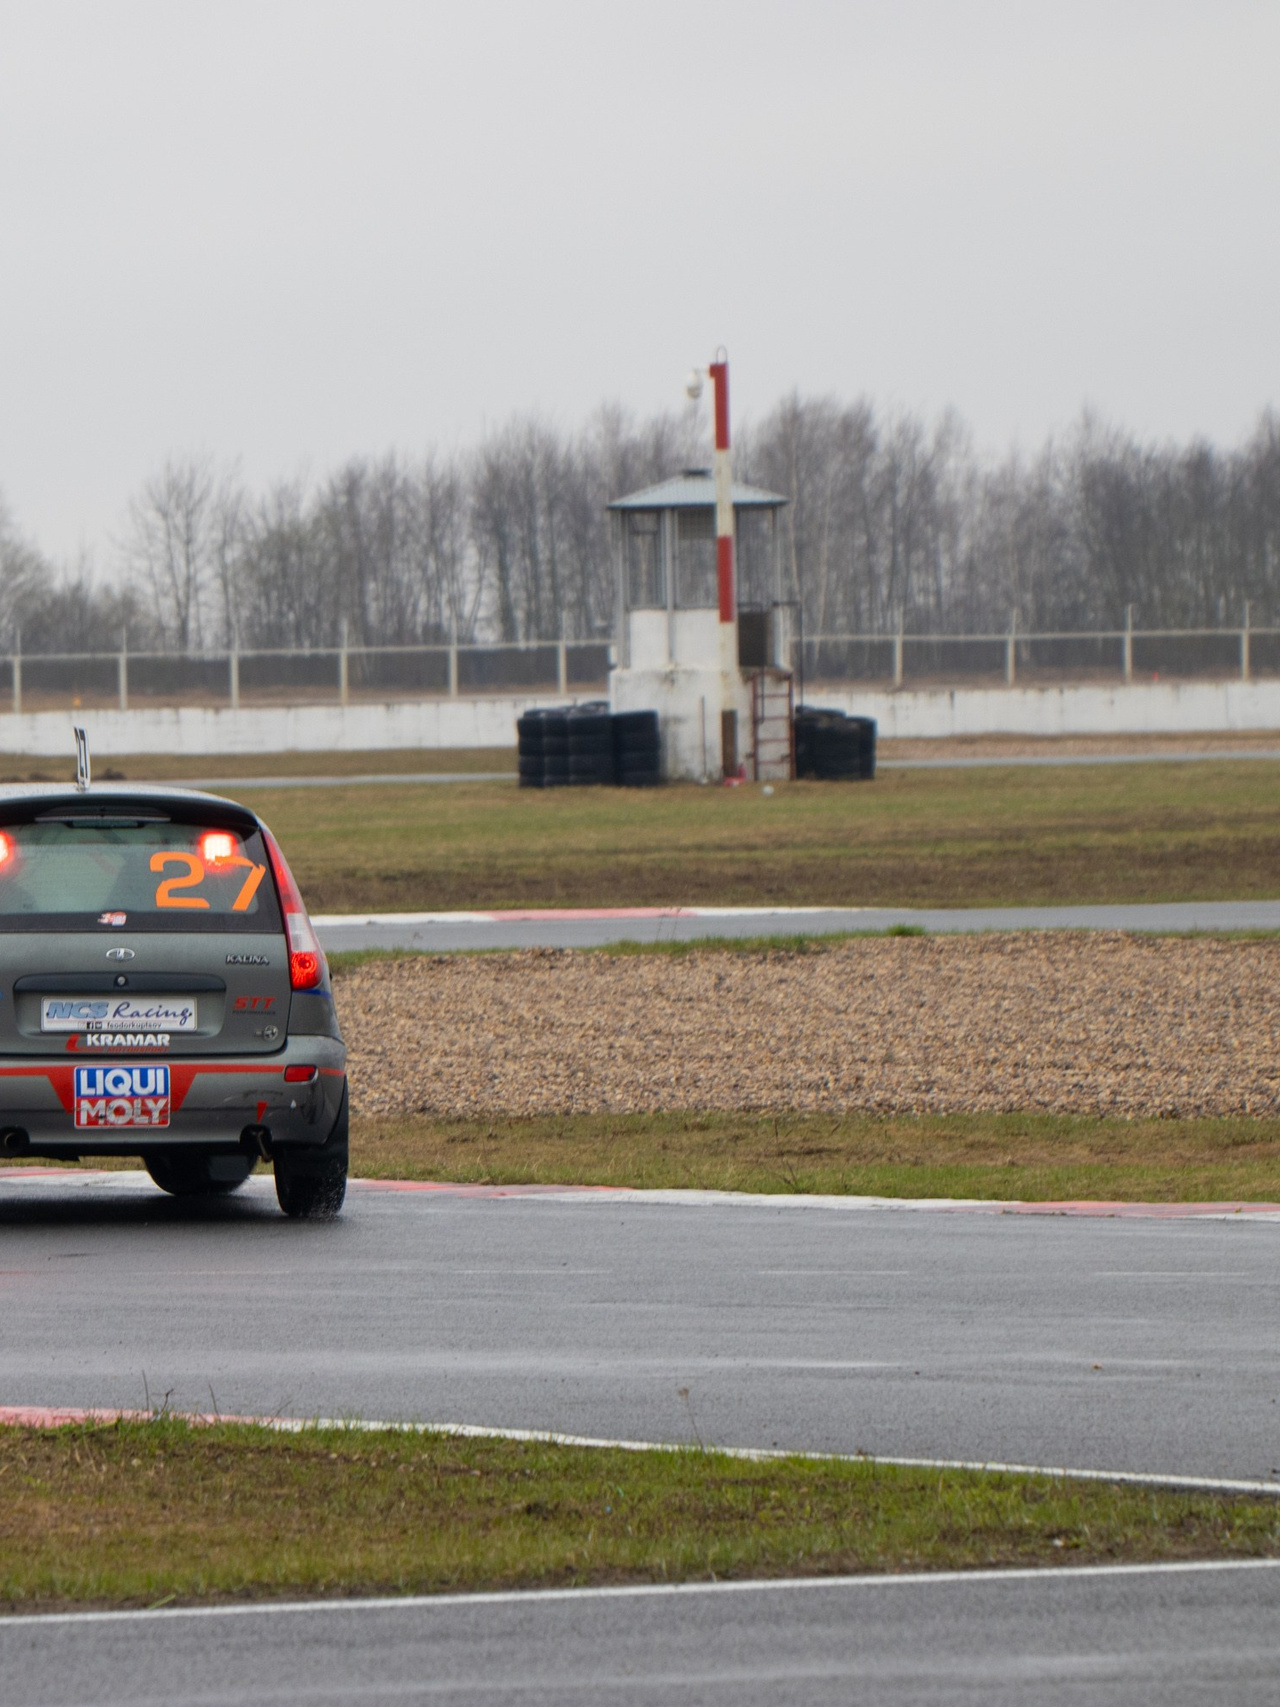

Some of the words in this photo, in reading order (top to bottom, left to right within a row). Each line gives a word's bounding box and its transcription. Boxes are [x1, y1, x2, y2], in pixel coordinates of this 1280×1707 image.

[149, 851, 266, 911] 27
[226, 954, 269, 965] KALINA
[46, 1002, 110, 1019] NCS
[112, 1001, 191, 1025] Racing
[86, 1033, 170, 1047] KRAMAR
[79, 1068, 165, 1097] LIQUI
[79, 1098, 168, 1125] MOLY
